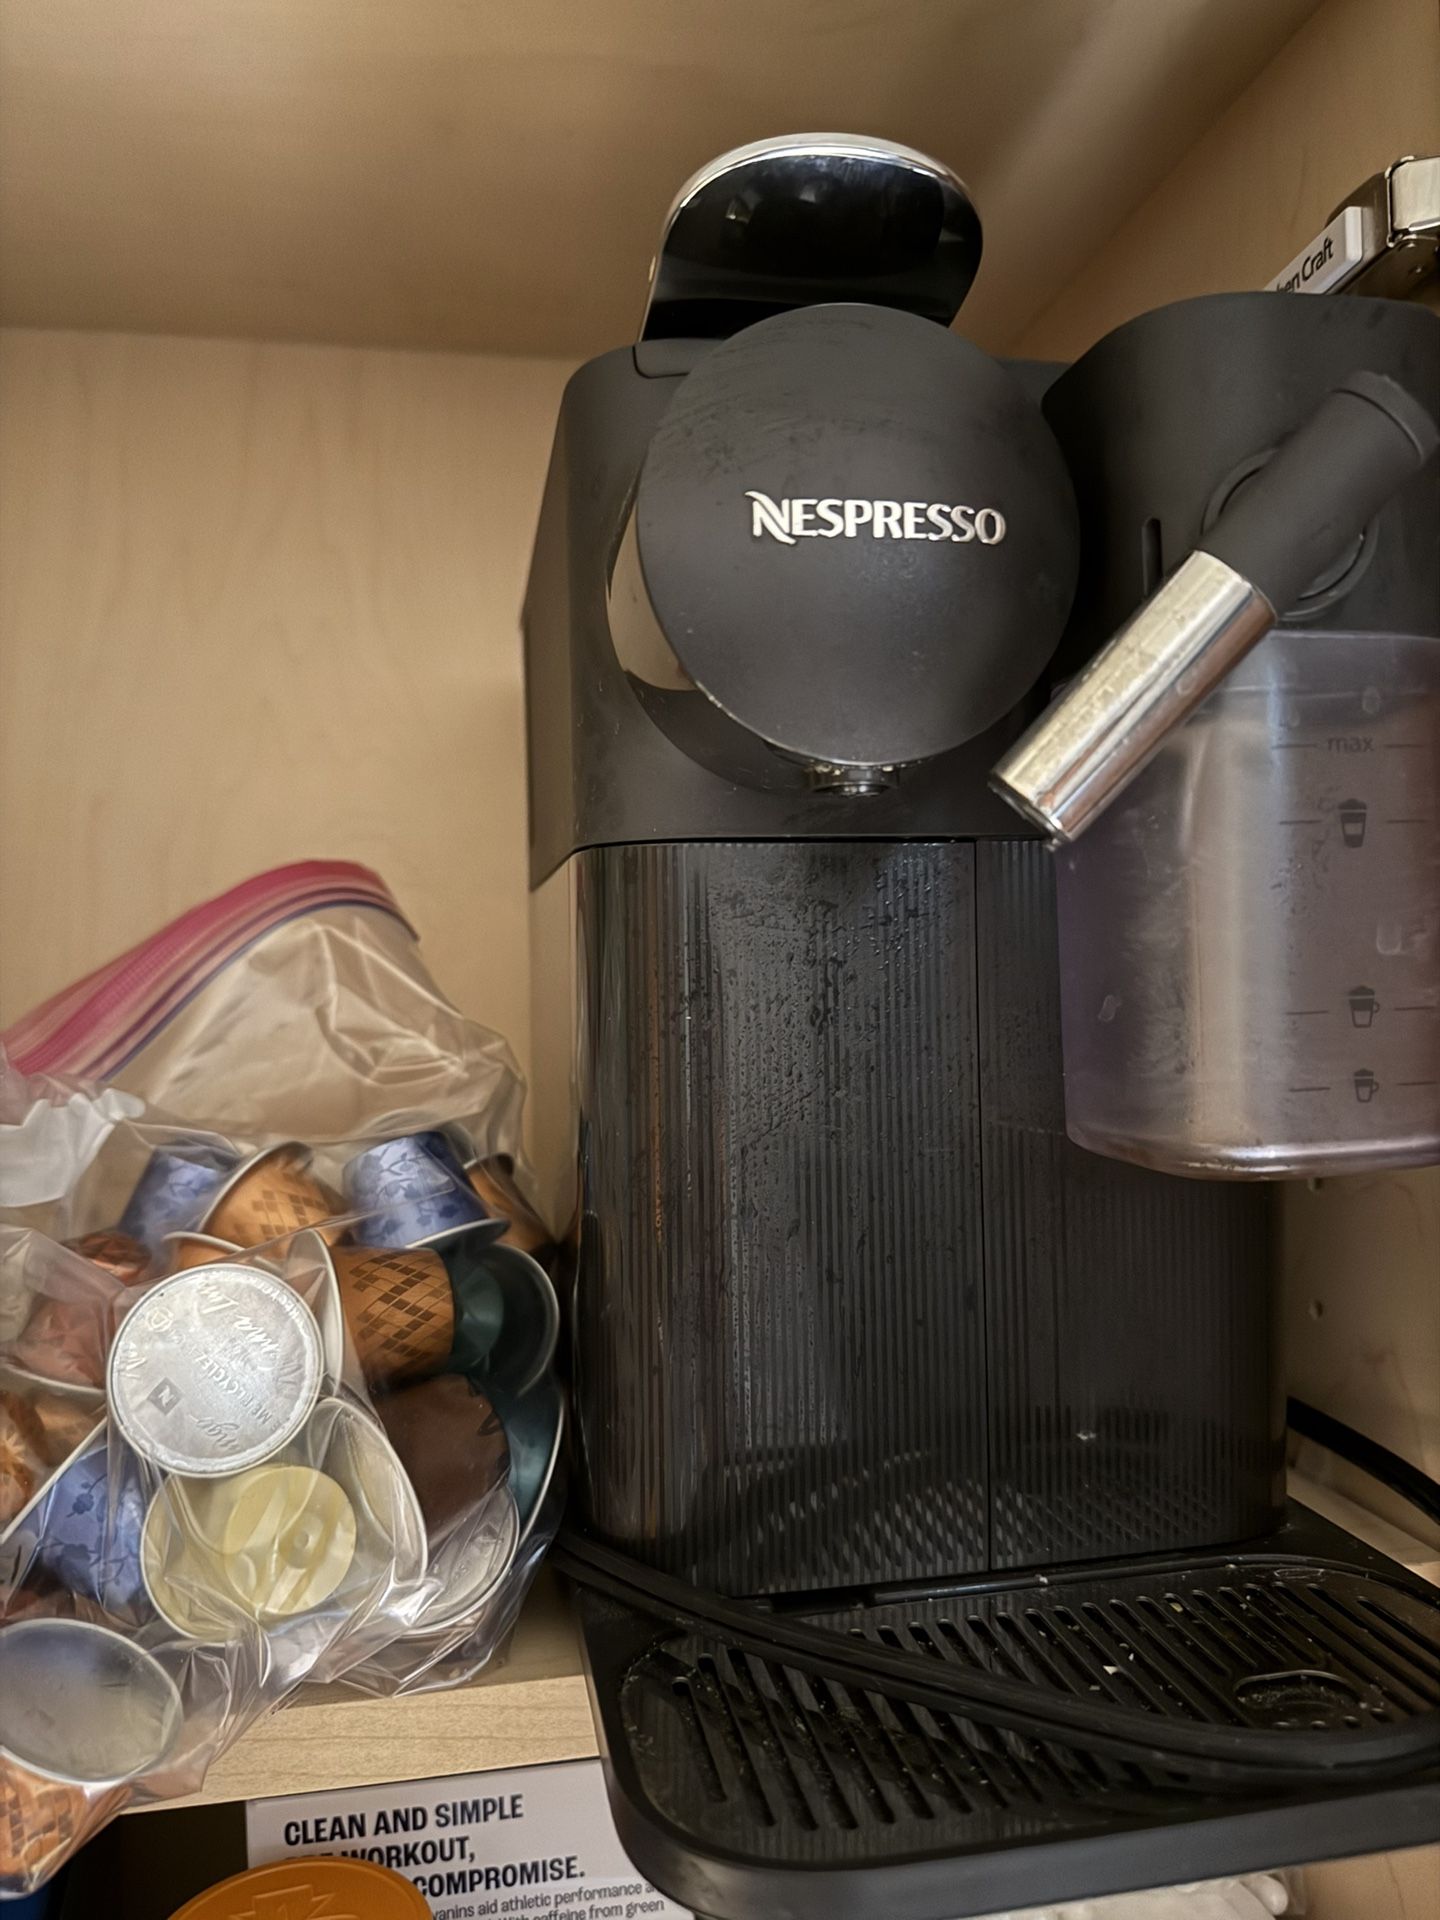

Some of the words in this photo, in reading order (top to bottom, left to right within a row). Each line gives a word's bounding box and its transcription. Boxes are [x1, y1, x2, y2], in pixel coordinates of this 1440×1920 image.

[1301, 236, 1334, 282] Craft
[744, 490, 1006, 545] NESPRESSO
[1327, 737, 1375, 752] max
[284, 1812, 366, 1846] CLEAN
[374, 1806, 428, 1836] AND
[435, 1794, 524, 1828] SIMPLE
[478, 1899, 498, 1915] aid
[501, 1894, 551, 1911] athletic
[555, 1882, 642, 1908] performance
[589, 1904, 623, 1920] from
[625, 1899, 665, 1918] green
